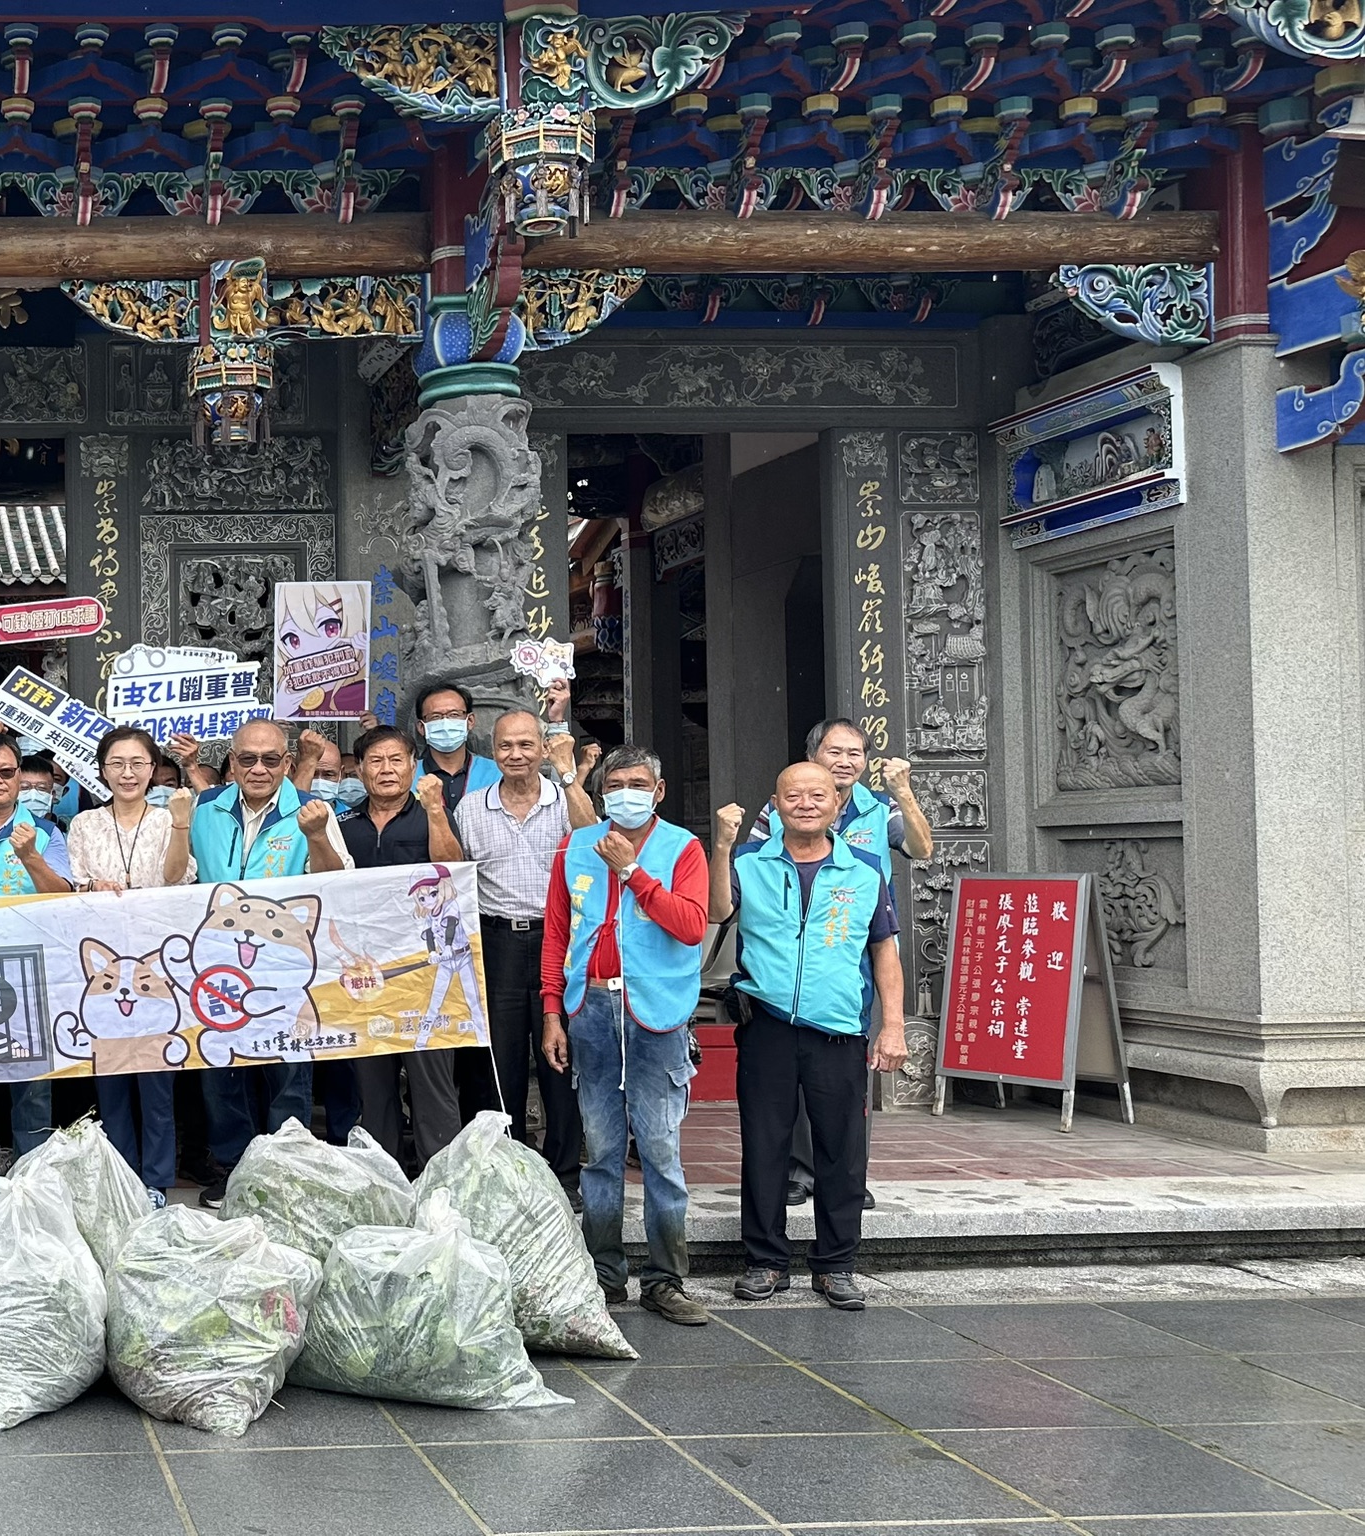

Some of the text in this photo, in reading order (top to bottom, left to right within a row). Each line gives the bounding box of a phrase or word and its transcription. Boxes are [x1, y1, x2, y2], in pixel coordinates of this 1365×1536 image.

[11, 676, 58, 709] 打詐
[114, 671, 255, 708] 最重關12年!
[1017, 892, 1041, 983] 蒞臨參觀
[1045, 901, 1069, 972] 歡迎
[986, 893, 1015, 1039] 張廖元子公宗祠
[203, 978, 242, 1018] 詐
